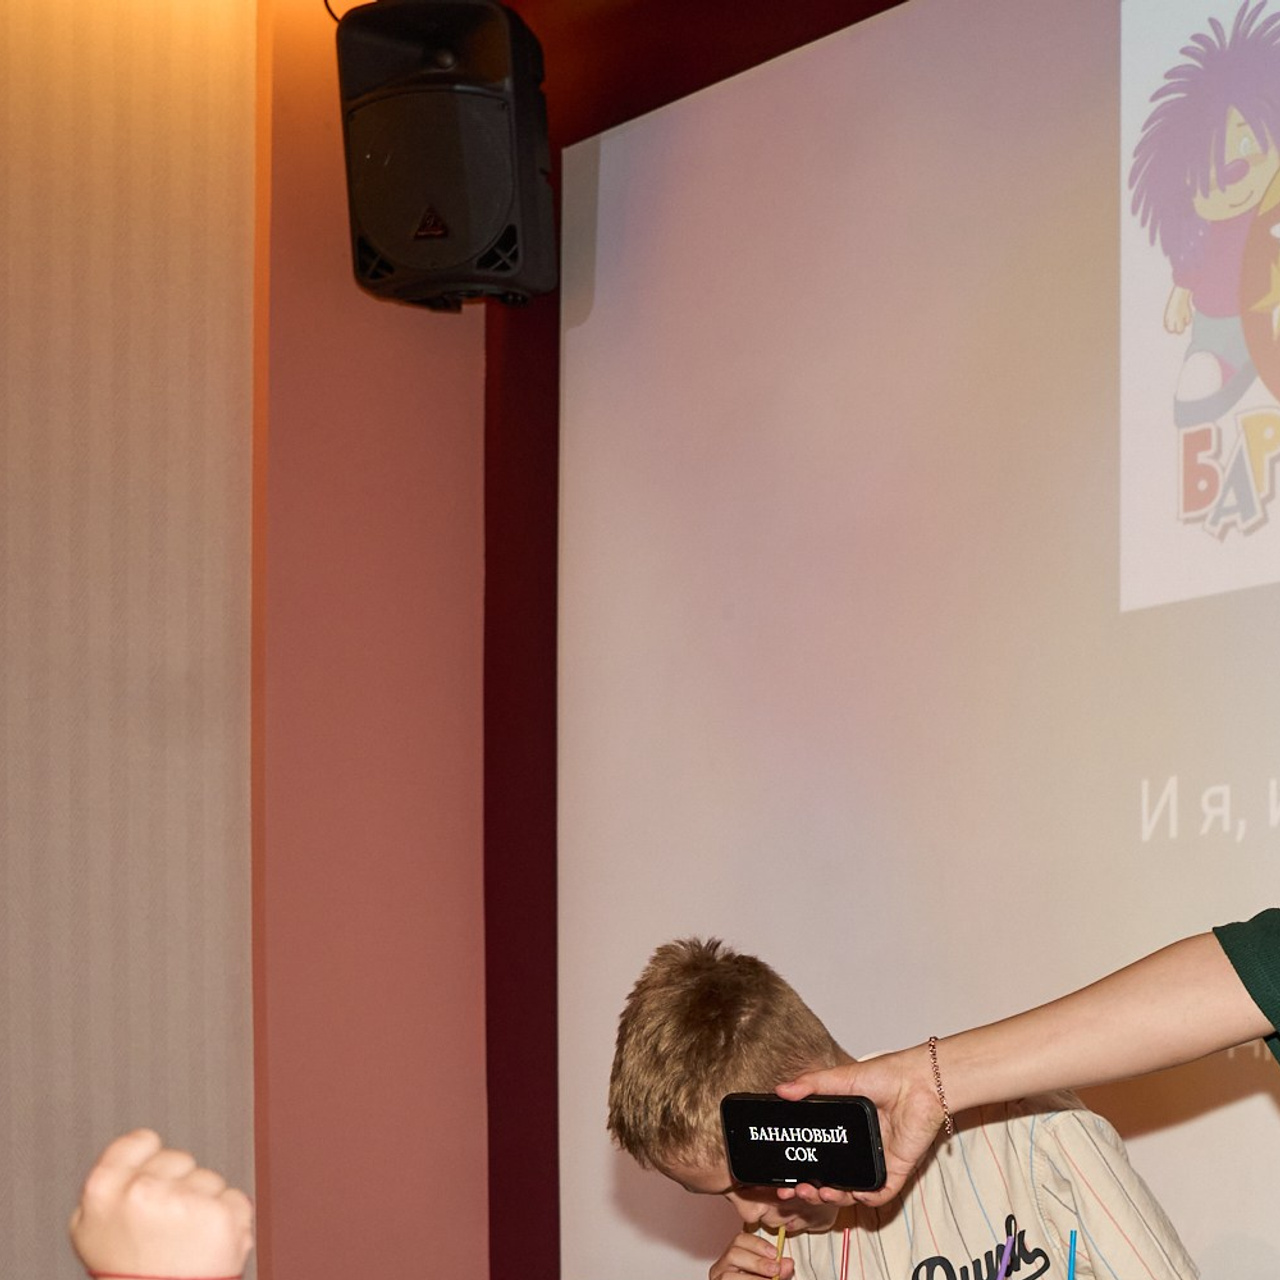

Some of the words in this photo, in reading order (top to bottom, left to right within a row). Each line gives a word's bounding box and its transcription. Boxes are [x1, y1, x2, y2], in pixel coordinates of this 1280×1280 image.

[1140, 774, 1178, 842] И
[748, 1125, 849, 1144] БАНАНОВЫЙ
[784, 1146, 819, 1162] СОК
